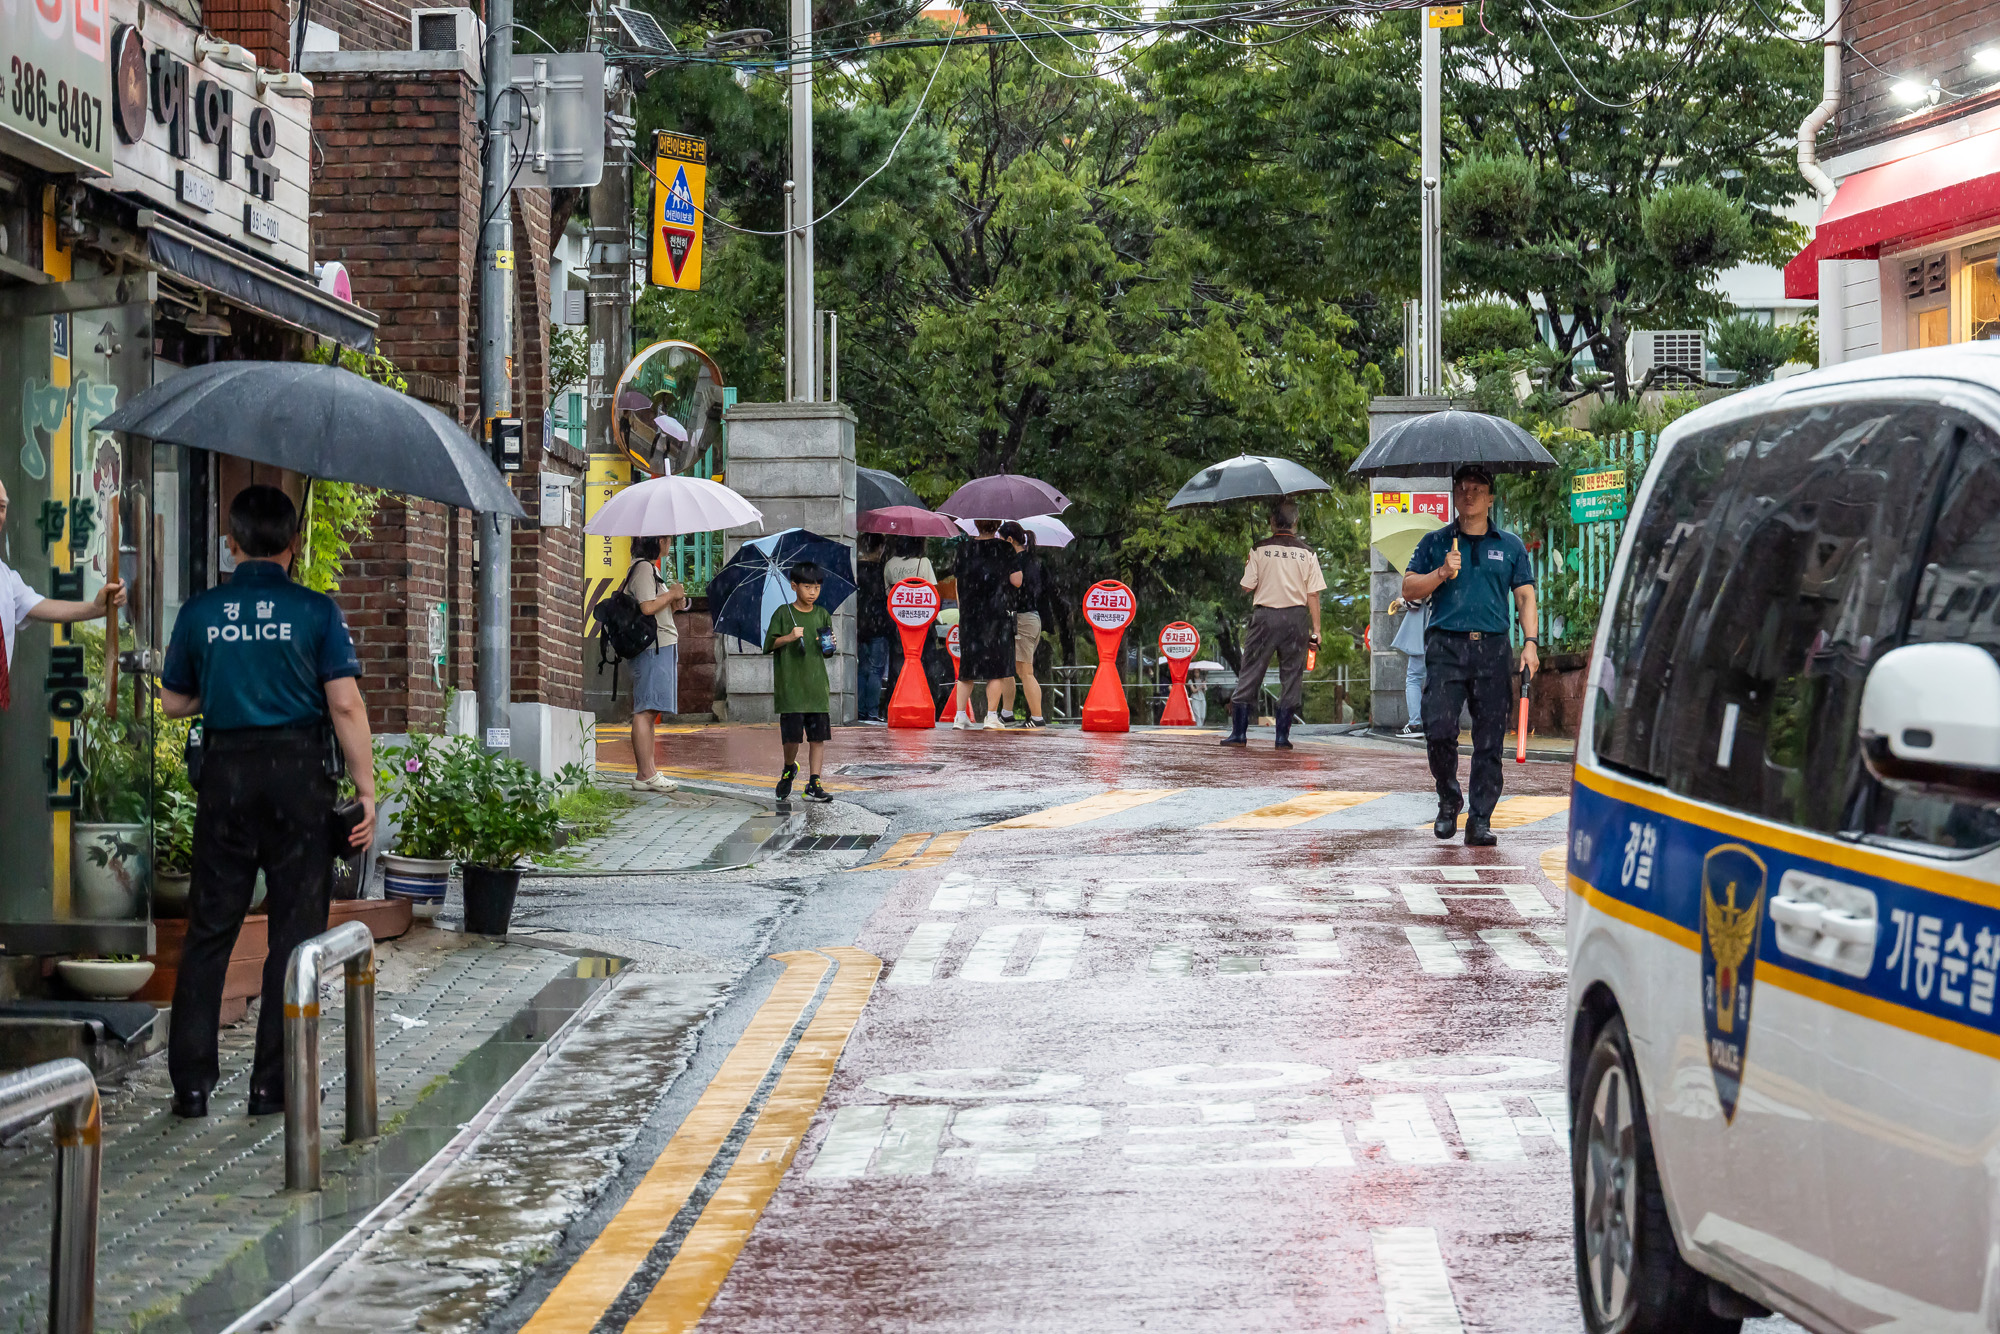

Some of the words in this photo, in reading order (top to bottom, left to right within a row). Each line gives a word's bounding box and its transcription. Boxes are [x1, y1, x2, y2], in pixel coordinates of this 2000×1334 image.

[11, 55, 102, 153] 386-8497
[659, 135, 705, 160] 어린이보호구역
[184, 179, 198, 199] HAIR
[199, 185, 214, 206] SHOP
[251, 210, 280, 240] 351-9001
[665, 209, 693, 223] 어린이보호
[670, 235, 688, 249] 천천히
[1418, 503, 1444, 514] 에스원
[896, 592, 932, 605] 주차금지
[1091, 595, 1127, 607] 주차금지
[207, 623, 292, 644] POLICE
[1165, 633, 1192, 642] 주차금지
[1621, 822, 1656, 890] 경찰
[1886, 908, 2000, 1015] 기동순찰
